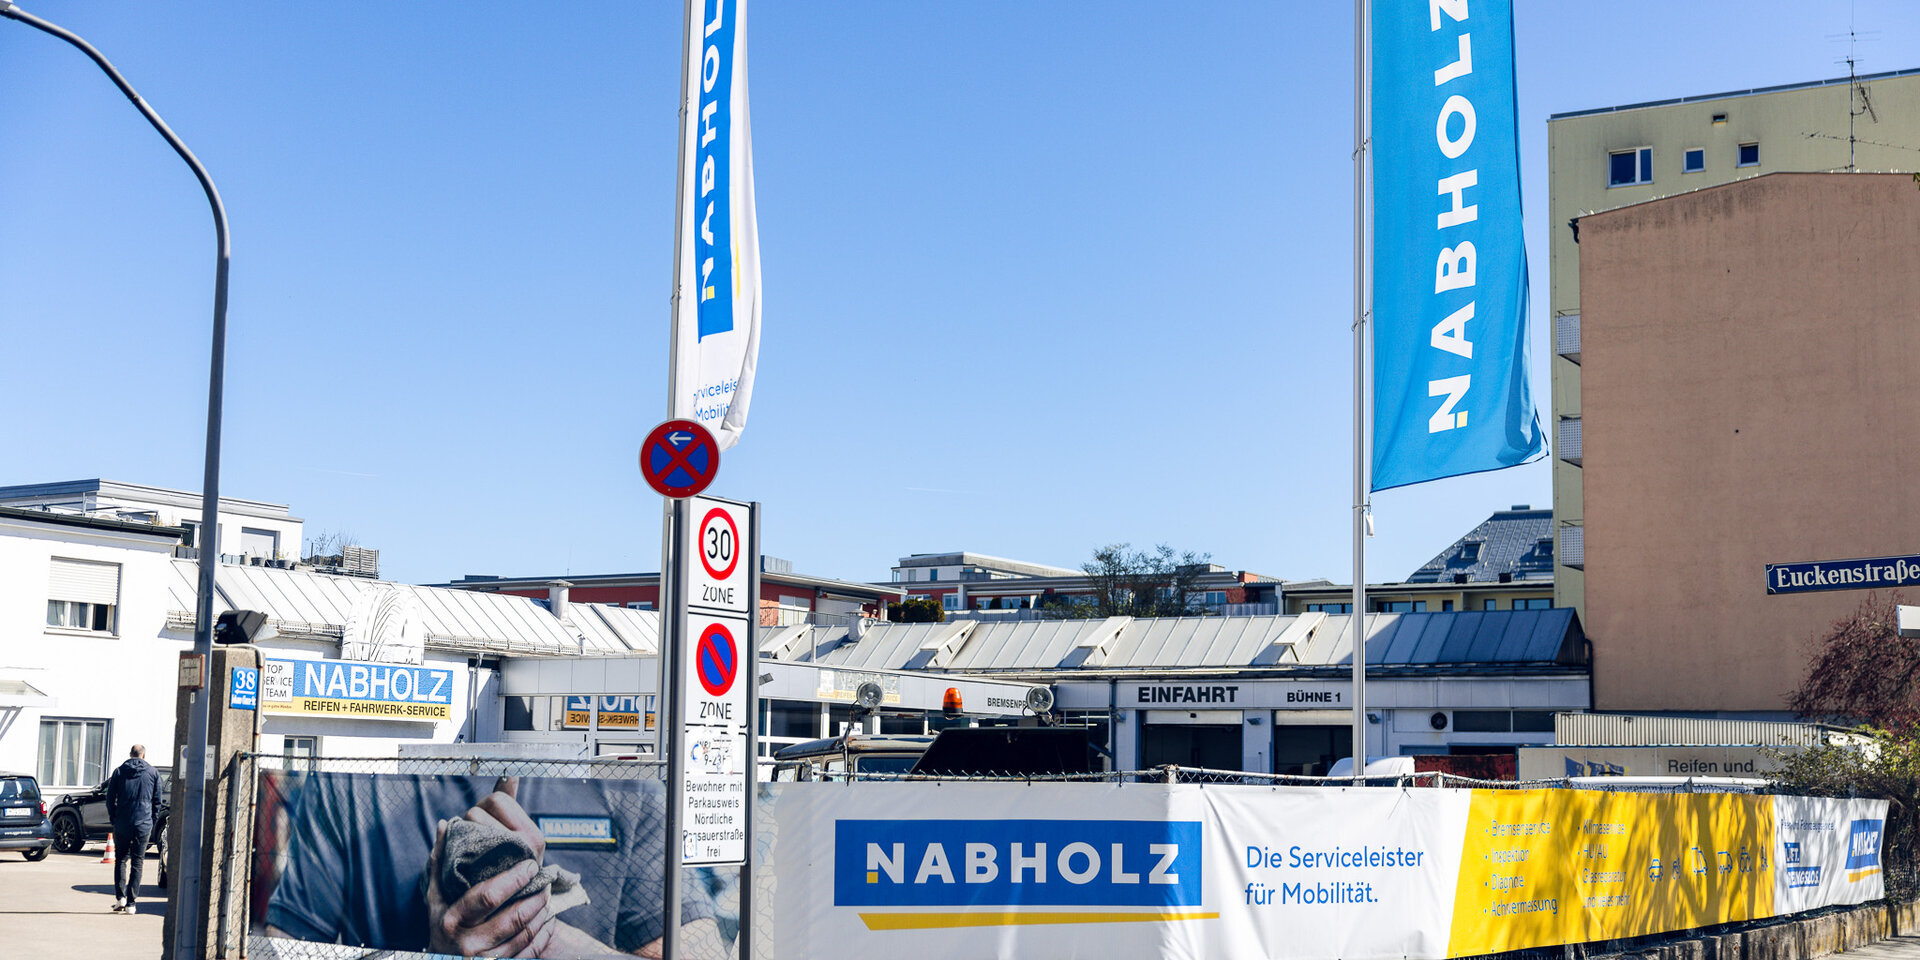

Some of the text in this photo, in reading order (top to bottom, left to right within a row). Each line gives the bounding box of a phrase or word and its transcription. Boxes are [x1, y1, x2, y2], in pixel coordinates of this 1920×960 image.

[707, 527, 731, 561] 30
[1776, 559, 1920, 588] Euckenstraße
[703, 584, 734, 605] ZONE
[267, 664, 283, 674] TOP
[236, 670, 255, 690] 38
[304, 662, 447, 702] NABHOLZ
[266, 688, 287, 698] TEAM
[1138, 686, 1239, 703] EINFAHRT
[1287, 690, 1341, 703] BÜHNE 1
[304, 701, 340, 712] REIFEN
[350, 703, 445, 717] FAHRWERK-SERVICE
[700, 702, 732, 719] ZONE
[1668, 759, 1753, 773] Reifen und
[686, 780, 743, 792] Bewohner mit
[689, 797, 739, 808] Parkausweis
[695, 813, 733, 825] Nördliche
[707, 846, 721, 858] frei
[1247, 845, 1424, 868] Die Serviceleister
[866, 841, 1179, 885] NABHOLZ
[1245, 882, 1378, 905] für Mobilität.
